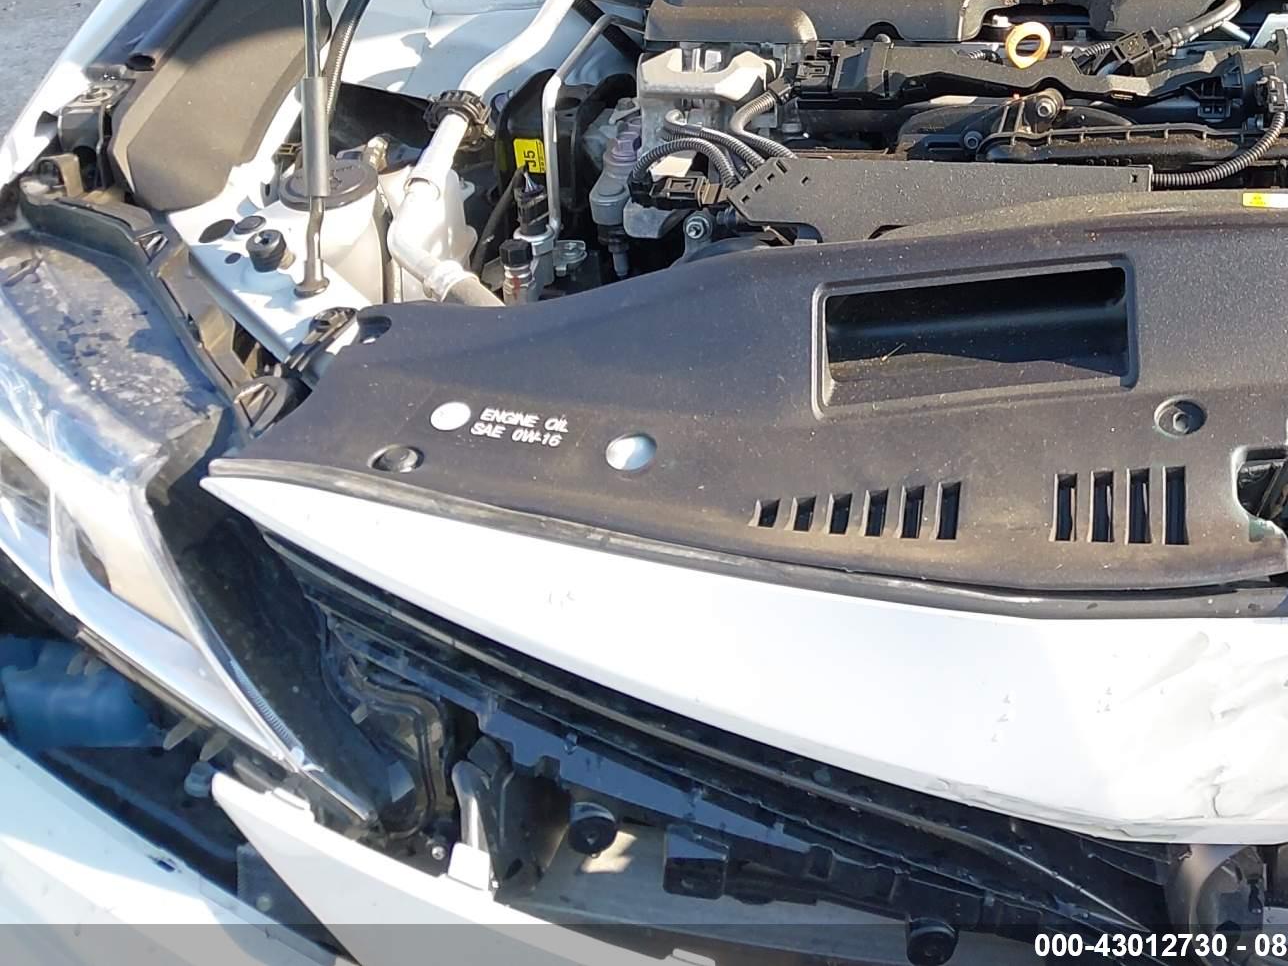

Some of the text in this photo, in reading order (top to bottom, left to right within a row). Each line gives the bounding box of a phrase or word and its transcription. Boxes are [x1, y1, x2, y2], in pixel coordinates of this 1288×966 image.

[480, 408, 568, 433] ENGINE OIL
[470, 422, 563, 446] SAE 0W-16
